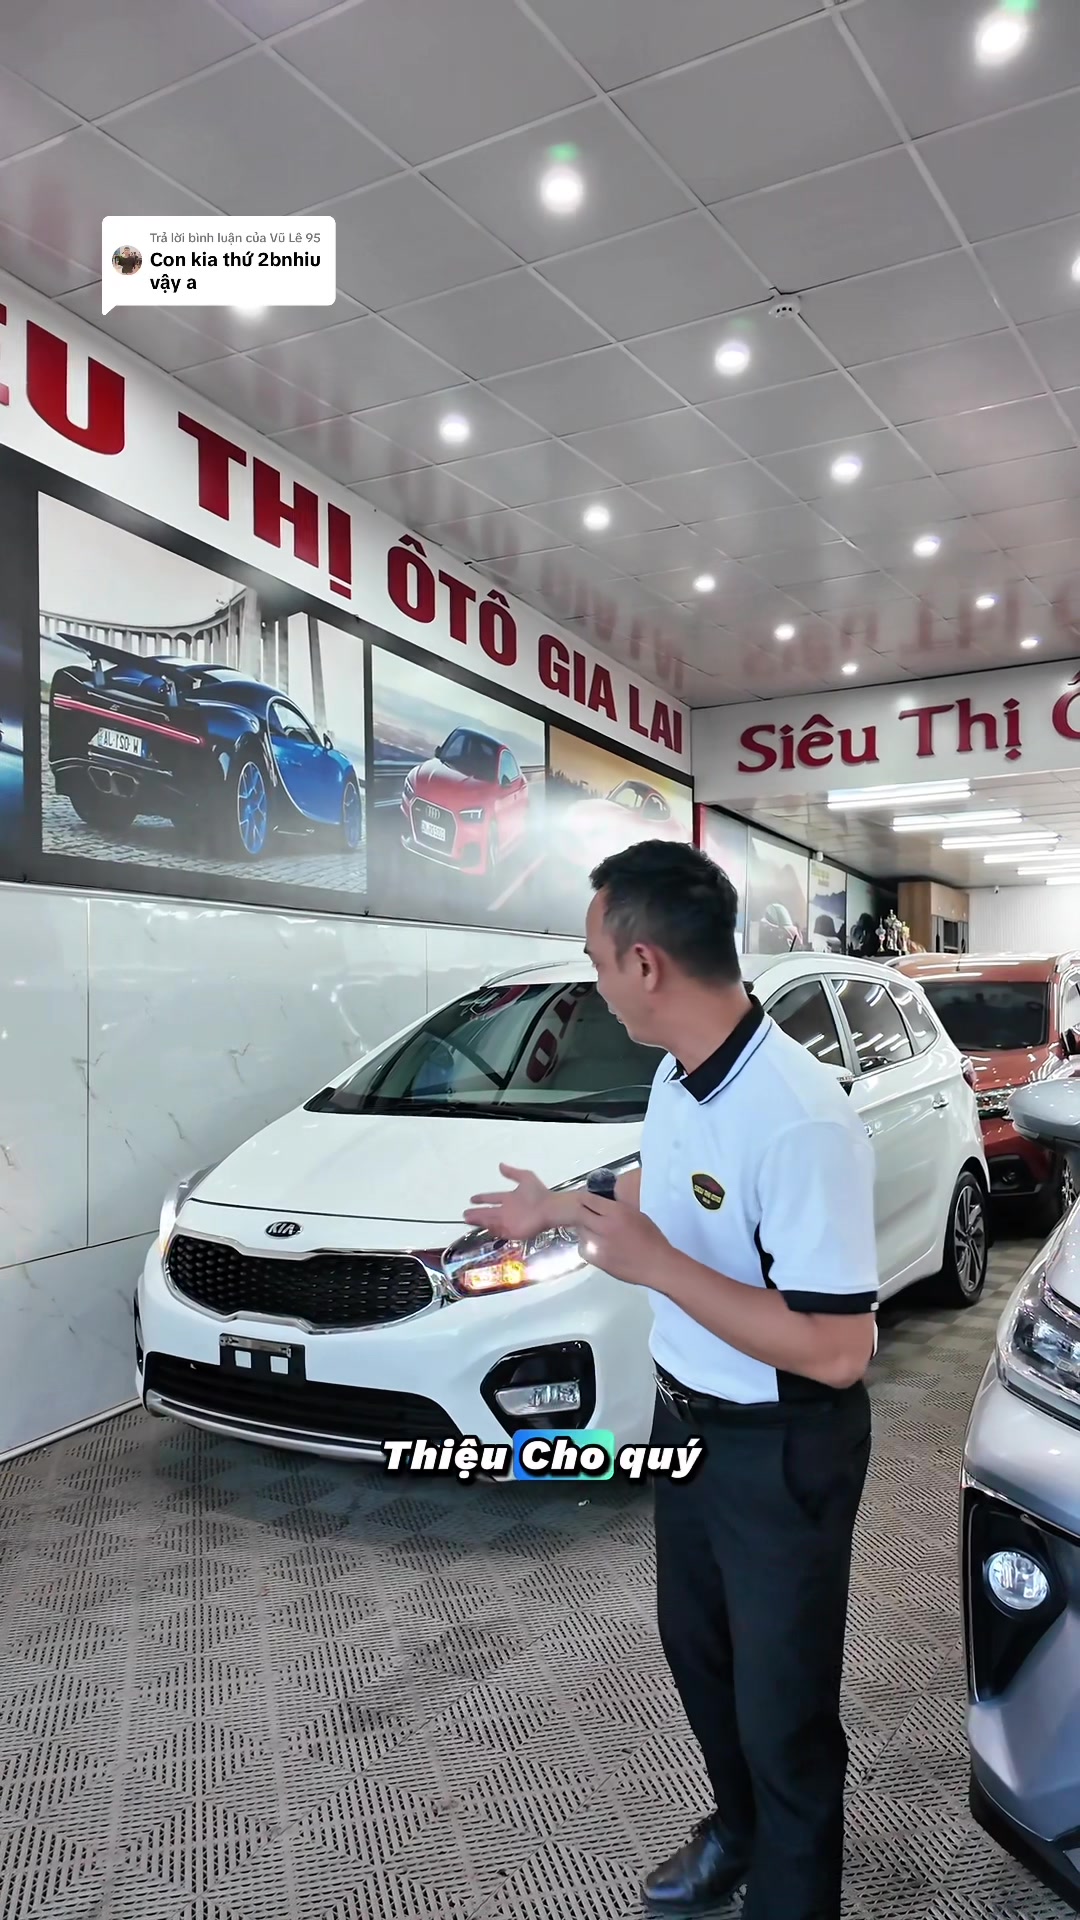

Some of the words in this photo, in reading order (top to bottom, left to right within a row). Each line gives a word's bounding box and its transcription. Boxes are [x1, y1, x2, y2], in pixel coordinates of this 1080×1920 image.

[0, 303, 126, 456] U
[178, 411, 352, 599] THỊ
[387, 533, 518, 667] ÔTÔ
[538, 633, 617, 721] GIA
[628, 683, 683, 755] LAI
[738, 713, 880, 773] Siêu
[898, 697, 1023, 762] Thị
[267, 1222, 296, 1235] KIA
